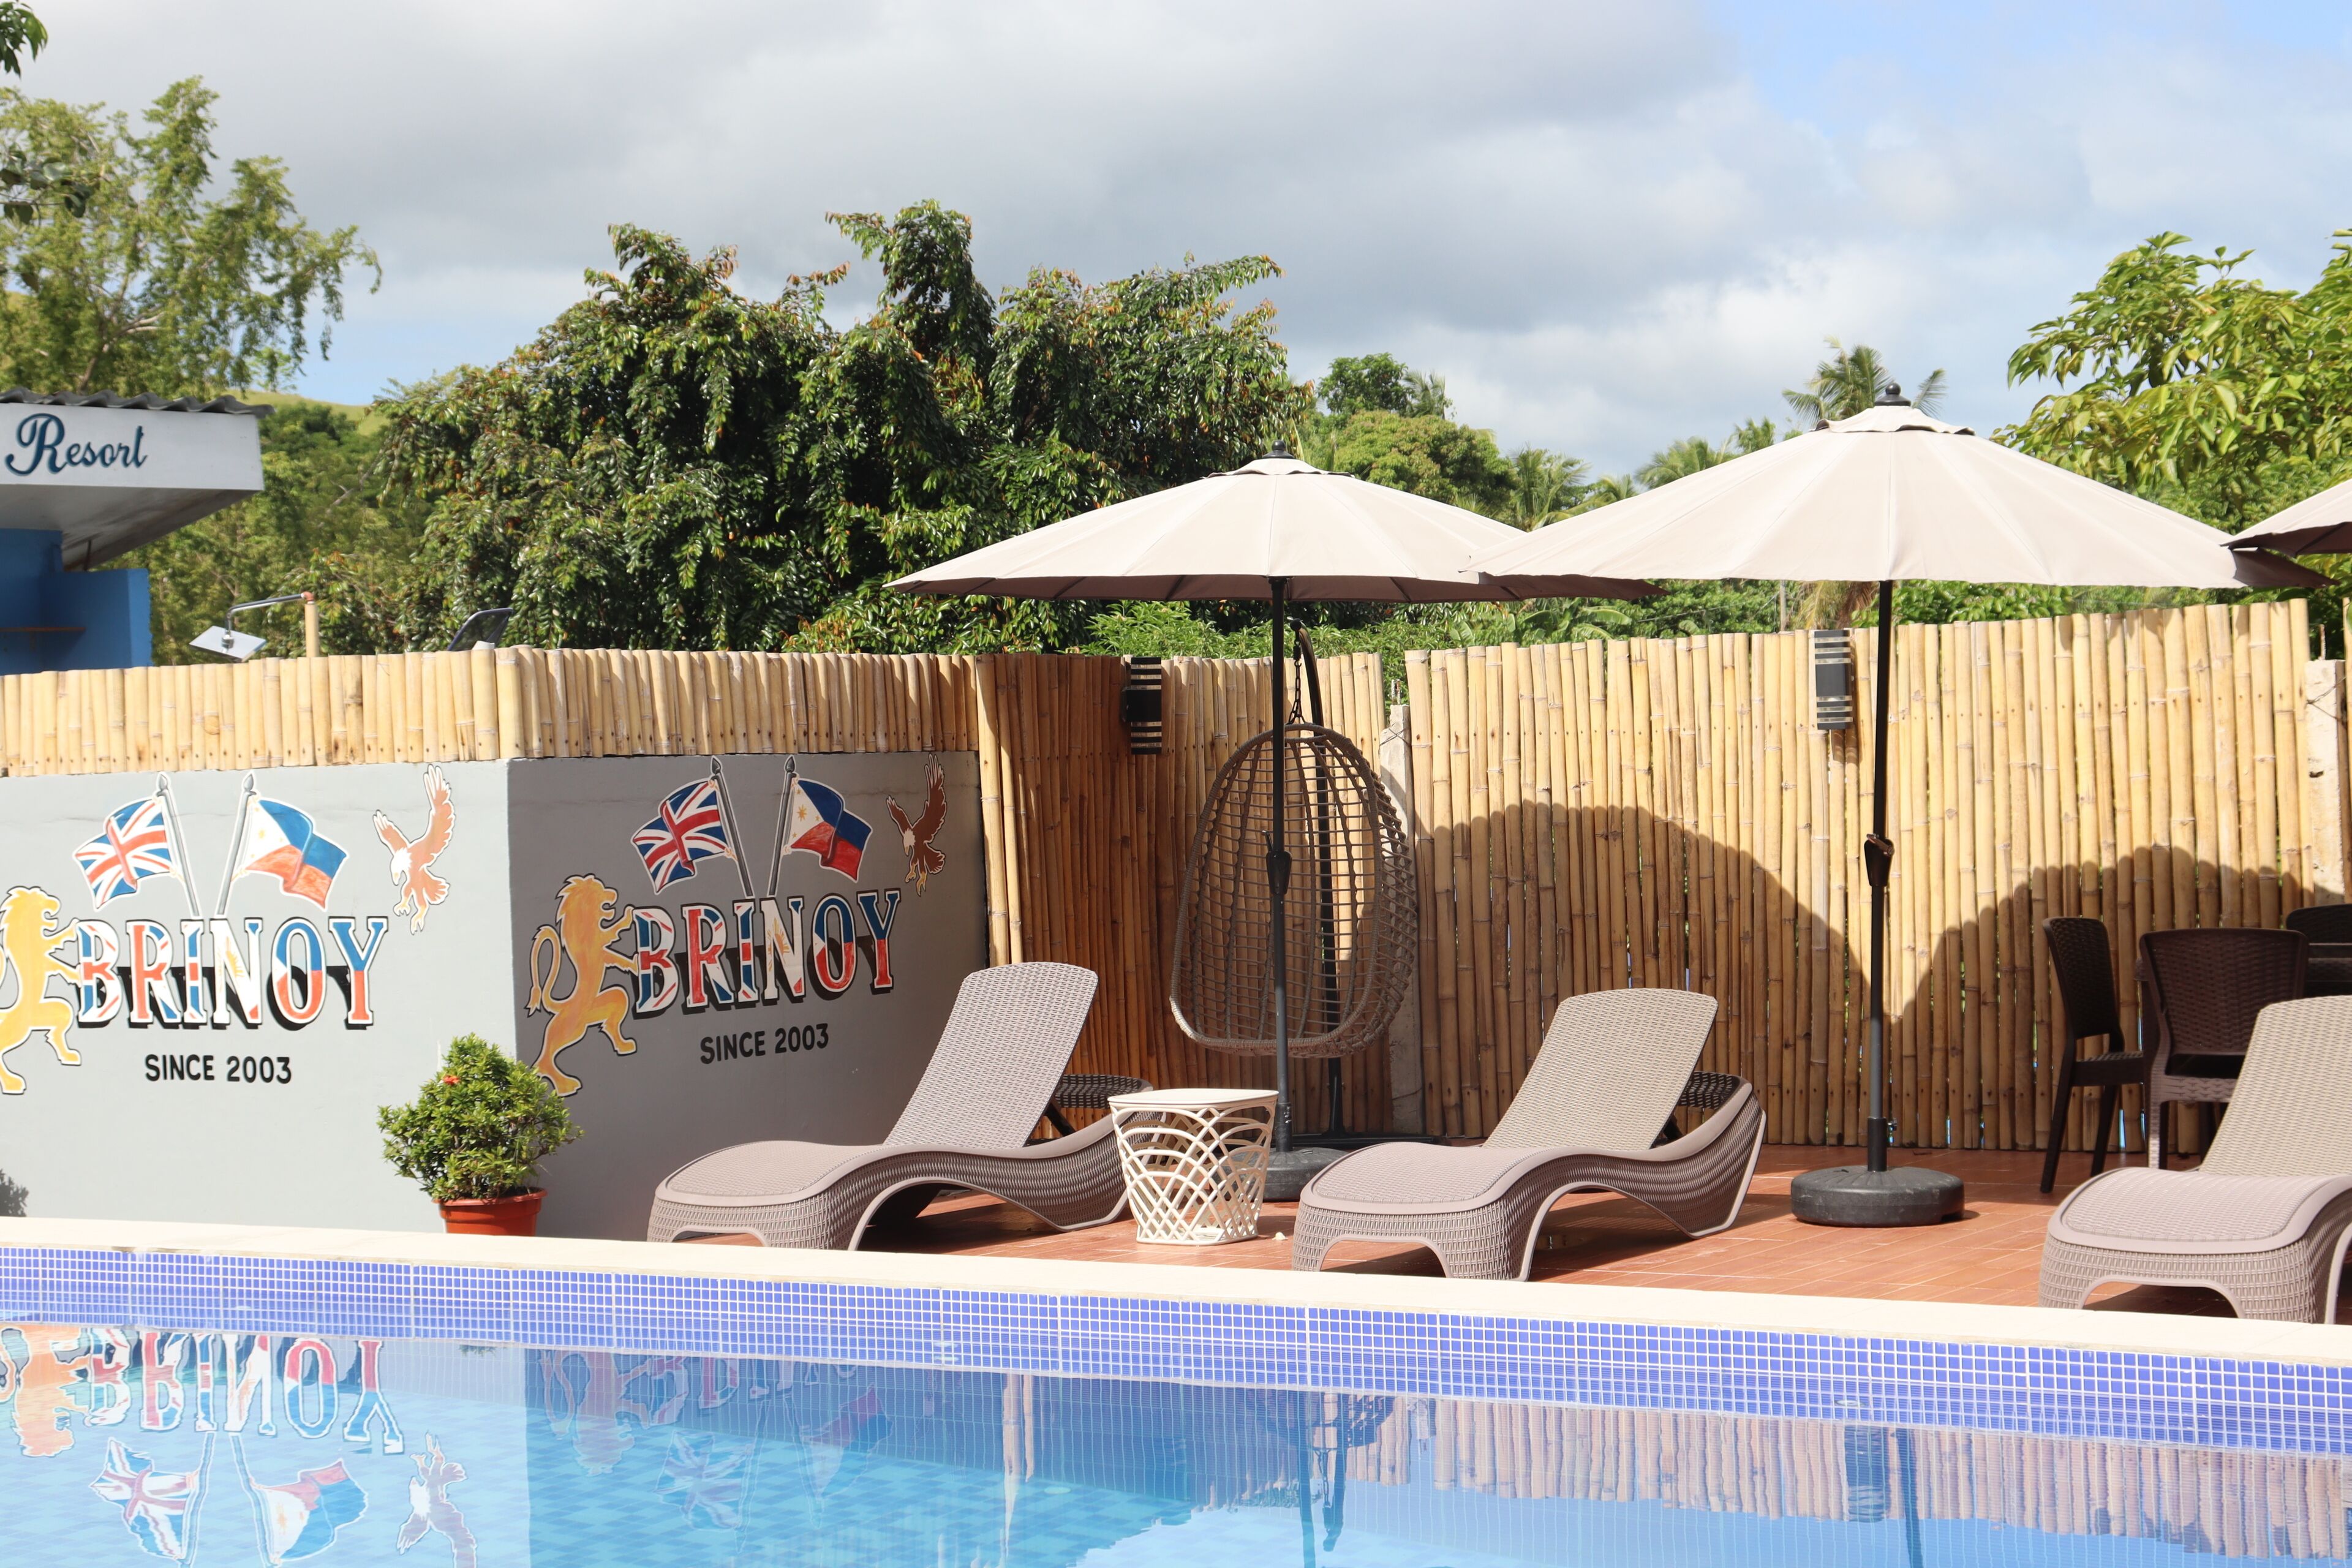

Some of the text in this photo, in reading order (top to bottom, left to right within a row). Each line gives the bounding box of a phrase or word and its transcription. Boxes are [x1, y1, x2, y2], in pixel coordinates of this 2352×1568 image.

[5, 413, 148, 476] Resort
[76, 916, 389, 1030] BRINOY
[631, 888, 902, 1019] BRINOY
[145, 1054, 292, 1084] SINCE 2003
[700, 1023, 829, 1064] SINCE 2003
